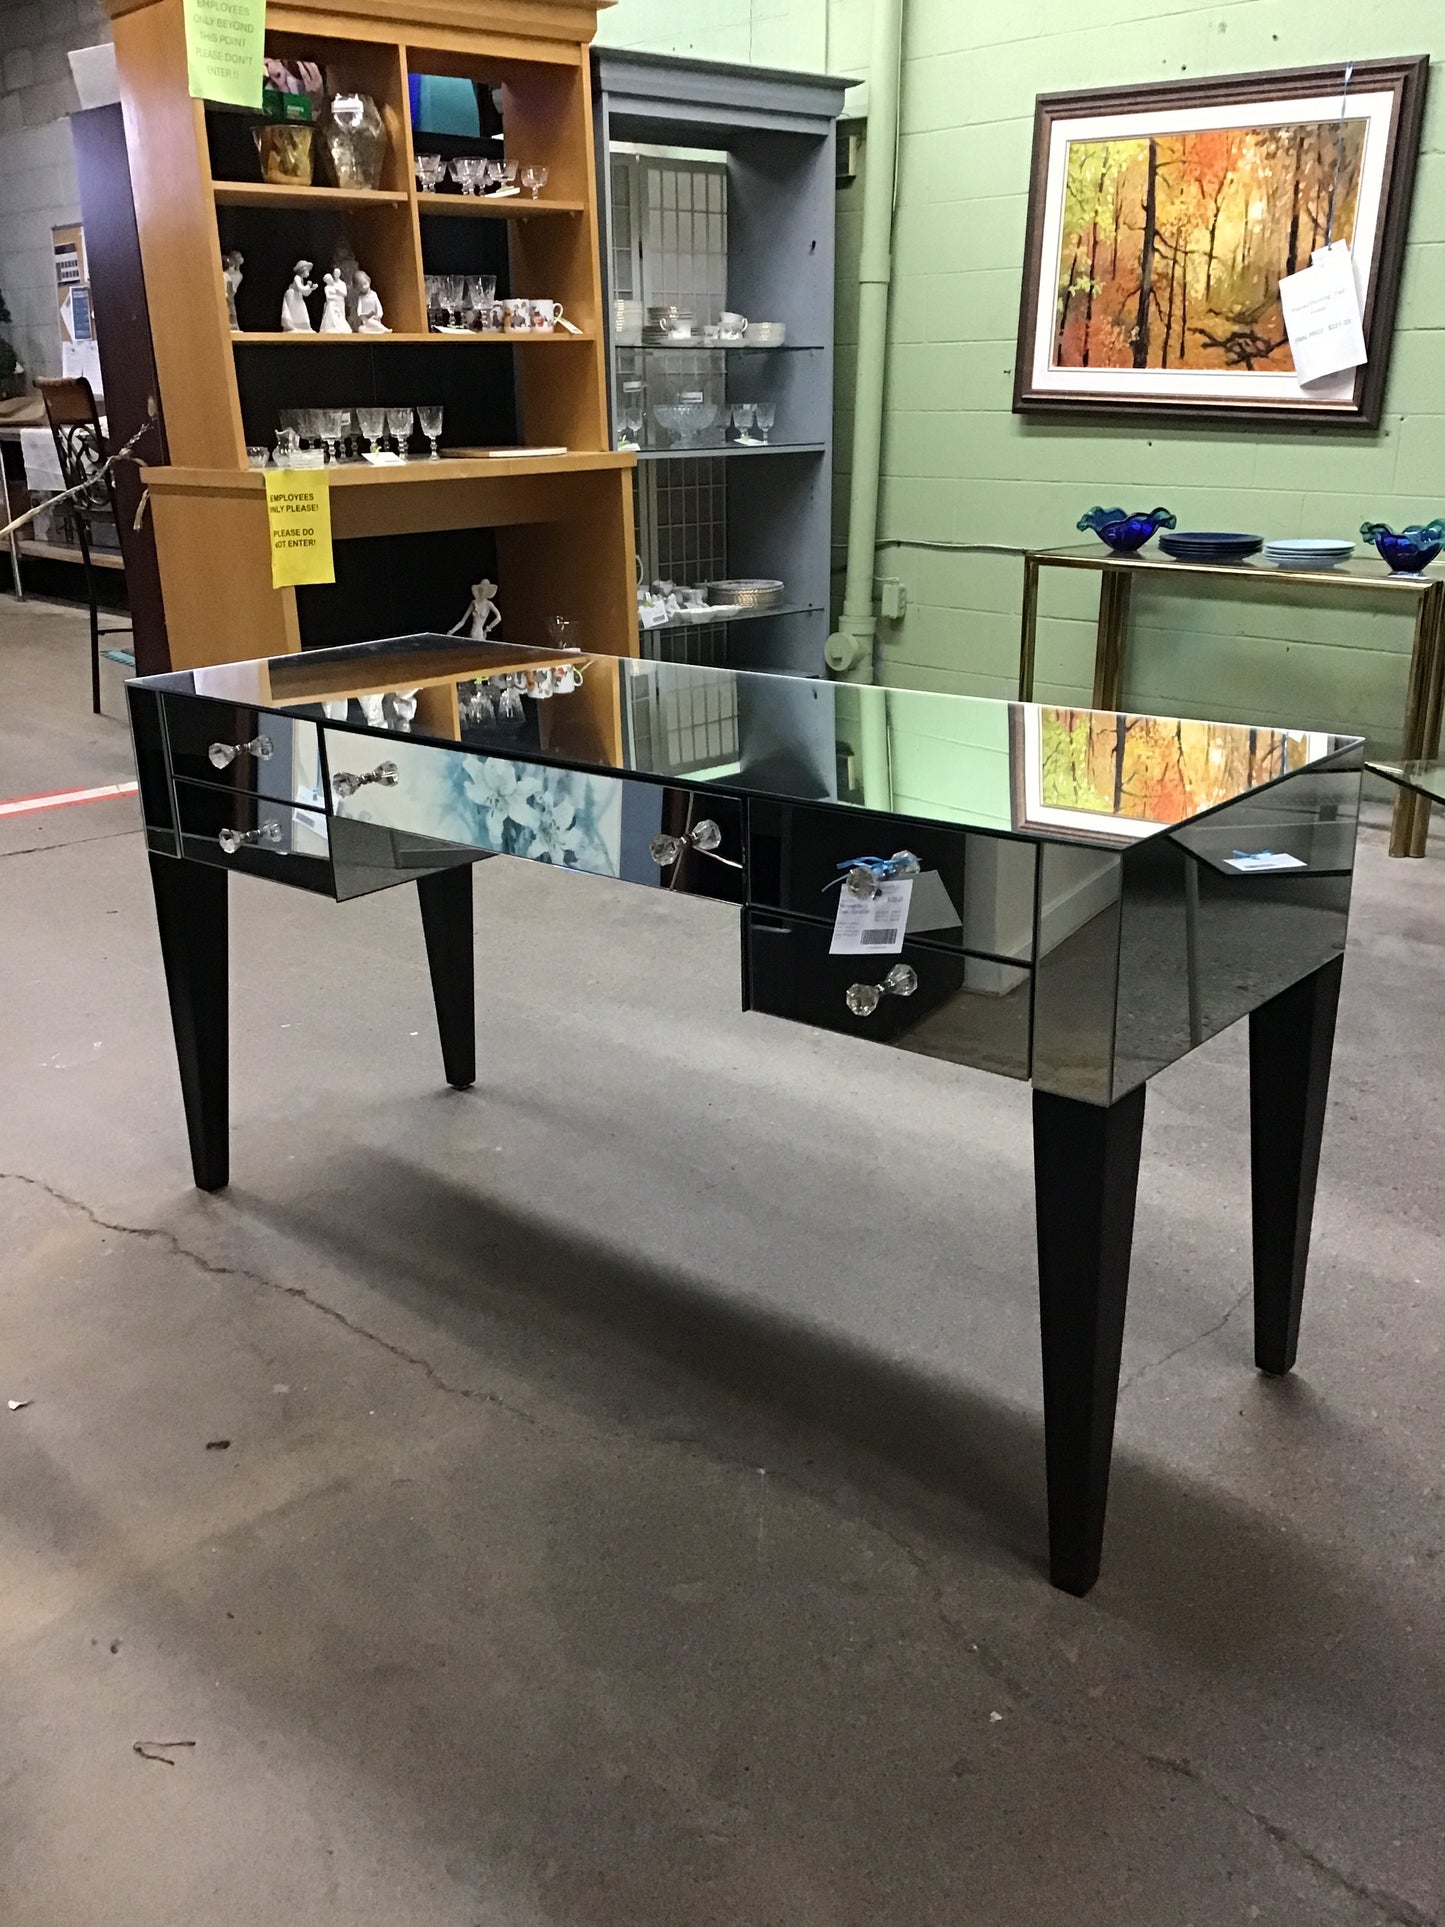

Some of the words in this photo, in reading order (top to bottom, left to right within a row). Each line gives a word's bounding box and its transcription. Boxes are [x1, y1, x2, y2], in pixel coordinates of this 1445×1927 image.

[197, 0, 250, 16] EMPLOYEES
[193, 13, 215, 26] ONLY
[217, 18, 255, 33] BEYOND
[200, 31, 218, 43] THIS
[220, 35, 246, 47] POINT
[196, 47, 224, 60] PLEASE
[225, 53, 253, 65] DON'T
[207, 65, 231, 78] ENTER
[270, 493, 314, 503] EMPLOYEES
[269, 505, 284, 514] NLY
[286, 504, 319, 513] PLEASE!
[273, 529, 300, 538] PLEASE
[302, 528, 314, 536] DO
[288, 539, 316, 548] ENTER!
